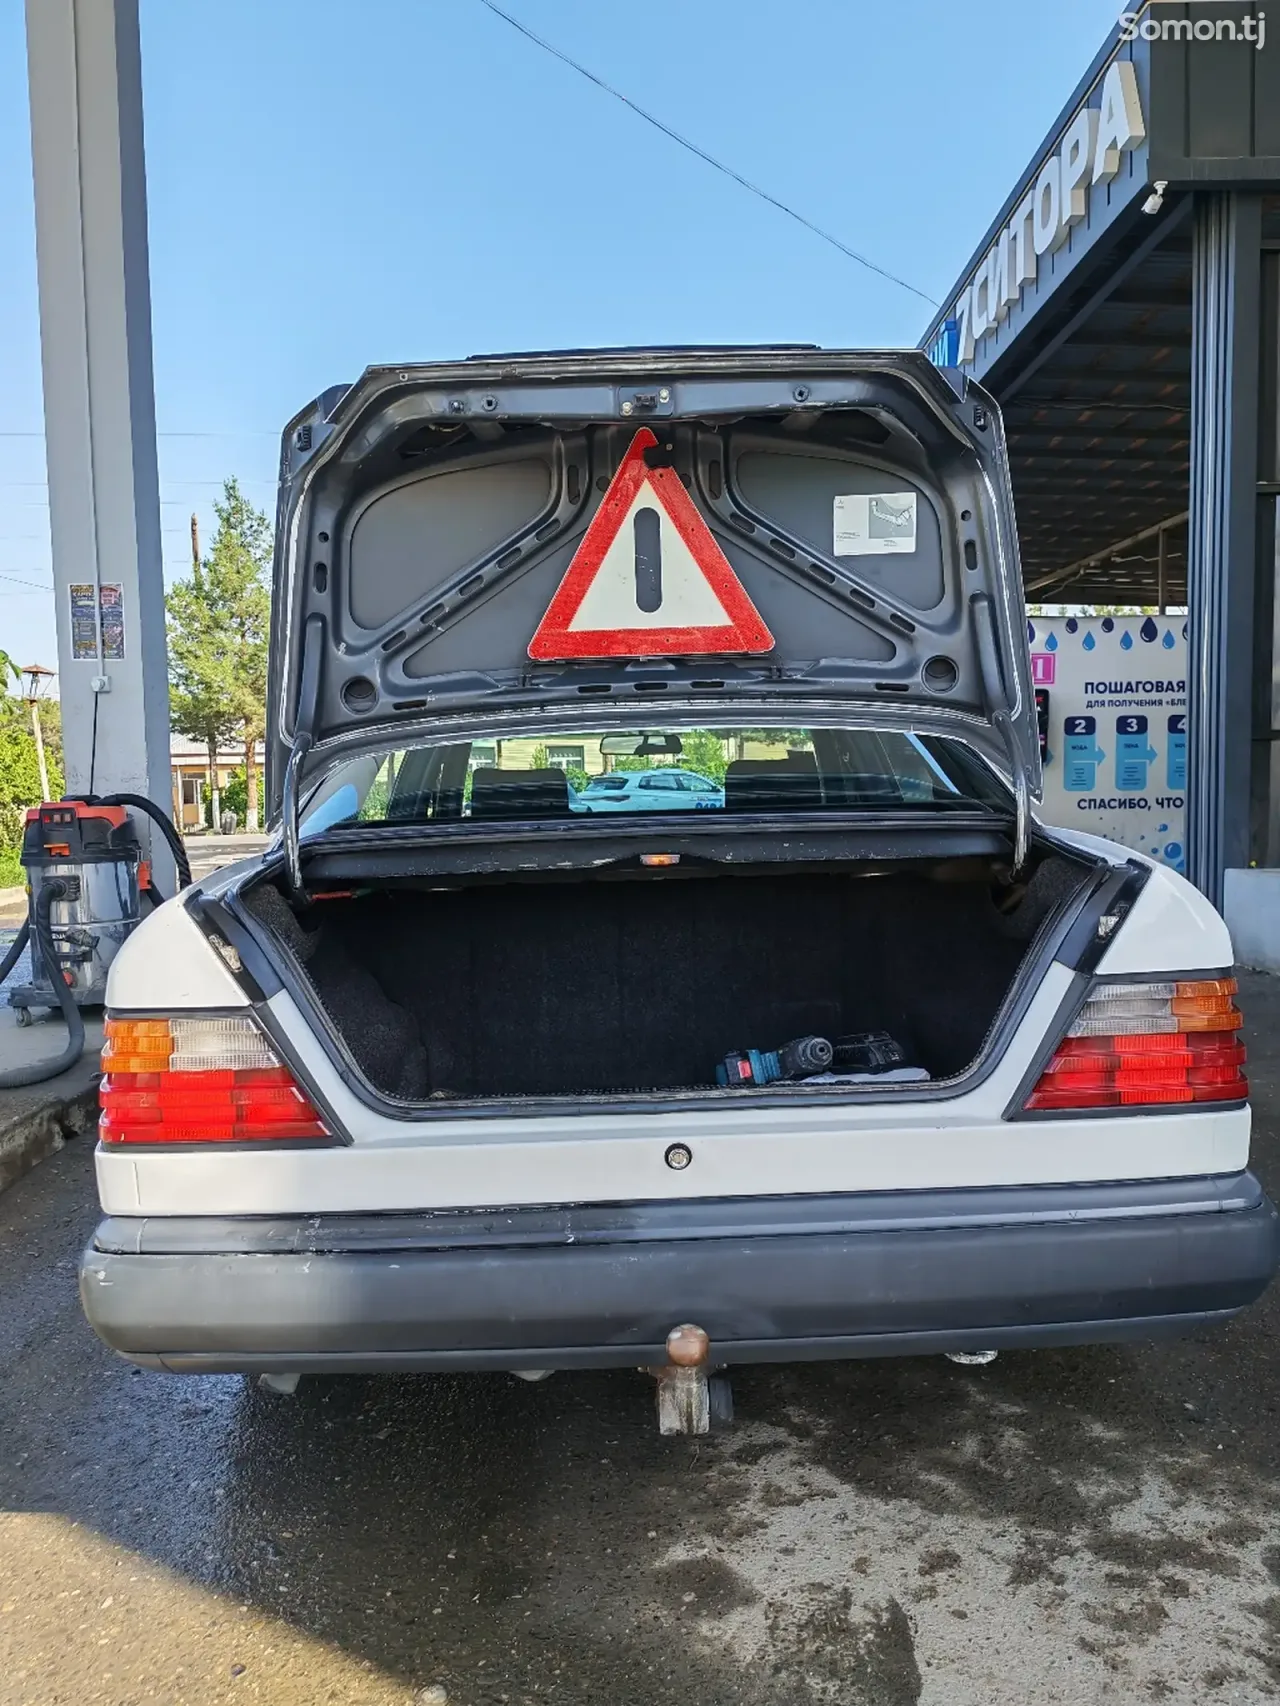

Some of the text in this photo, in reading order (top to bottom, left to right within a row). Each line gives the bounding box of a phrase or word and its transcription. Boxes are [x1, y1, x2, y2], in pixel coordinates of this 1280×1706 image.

[1084, 680, 1186, 695] ПОШАГОВАЯ
[1085, 699, 1106, 709] ДЛЯ
[1107, 698, 1164, 708] ПОЛУЧЕНИЯ
[1074, 719, 1087, 733] 2
[1126, 718, 1139, 732] 3
[1077, 796, 1185, 812] СПАСИБО, ЧТО
